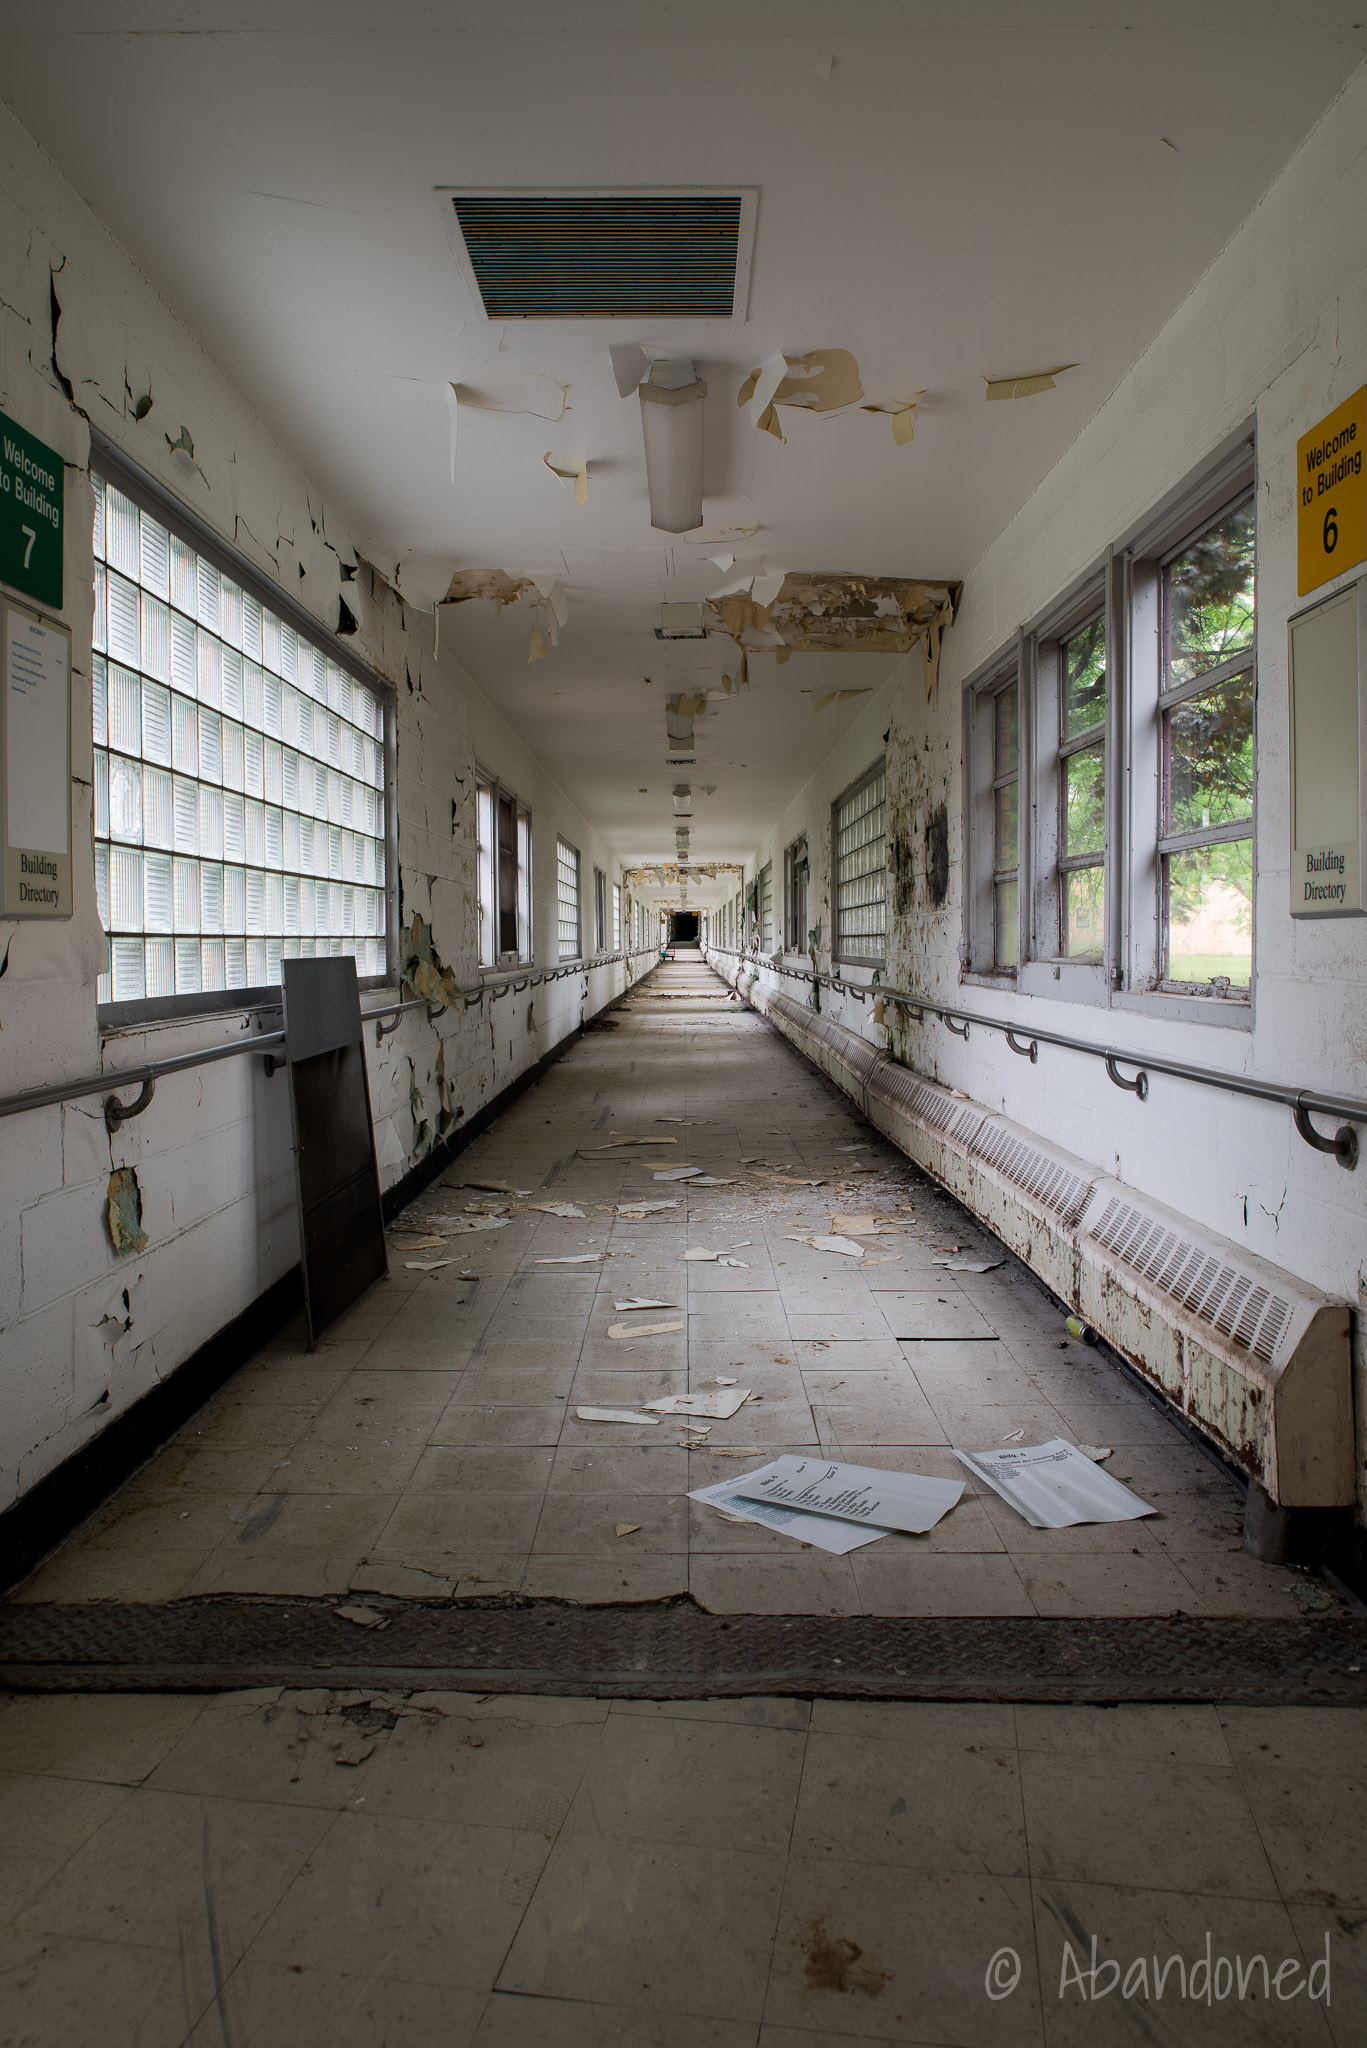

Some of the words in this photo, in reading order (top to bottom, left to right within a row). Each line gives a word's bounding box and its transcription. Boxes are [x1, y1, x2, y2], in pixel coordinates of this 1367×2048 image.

[3, 435, 56, 492] Welcome
[1306, 422, 1357, 473] Welcome
[1302, 486, 1314, 506] to
[1317, 450, 1362, 497] Building
[15, 476, 60, 529] Building
[22, 524, 37, 570] 7
[1323, 507, 1338, 554] 6
[20, 854, 58, 881] Building
[1306, 850, 1345, 874] Building
[19, 882, 60, 908] Directory
[1304, 881, 1347, 904] Directory
